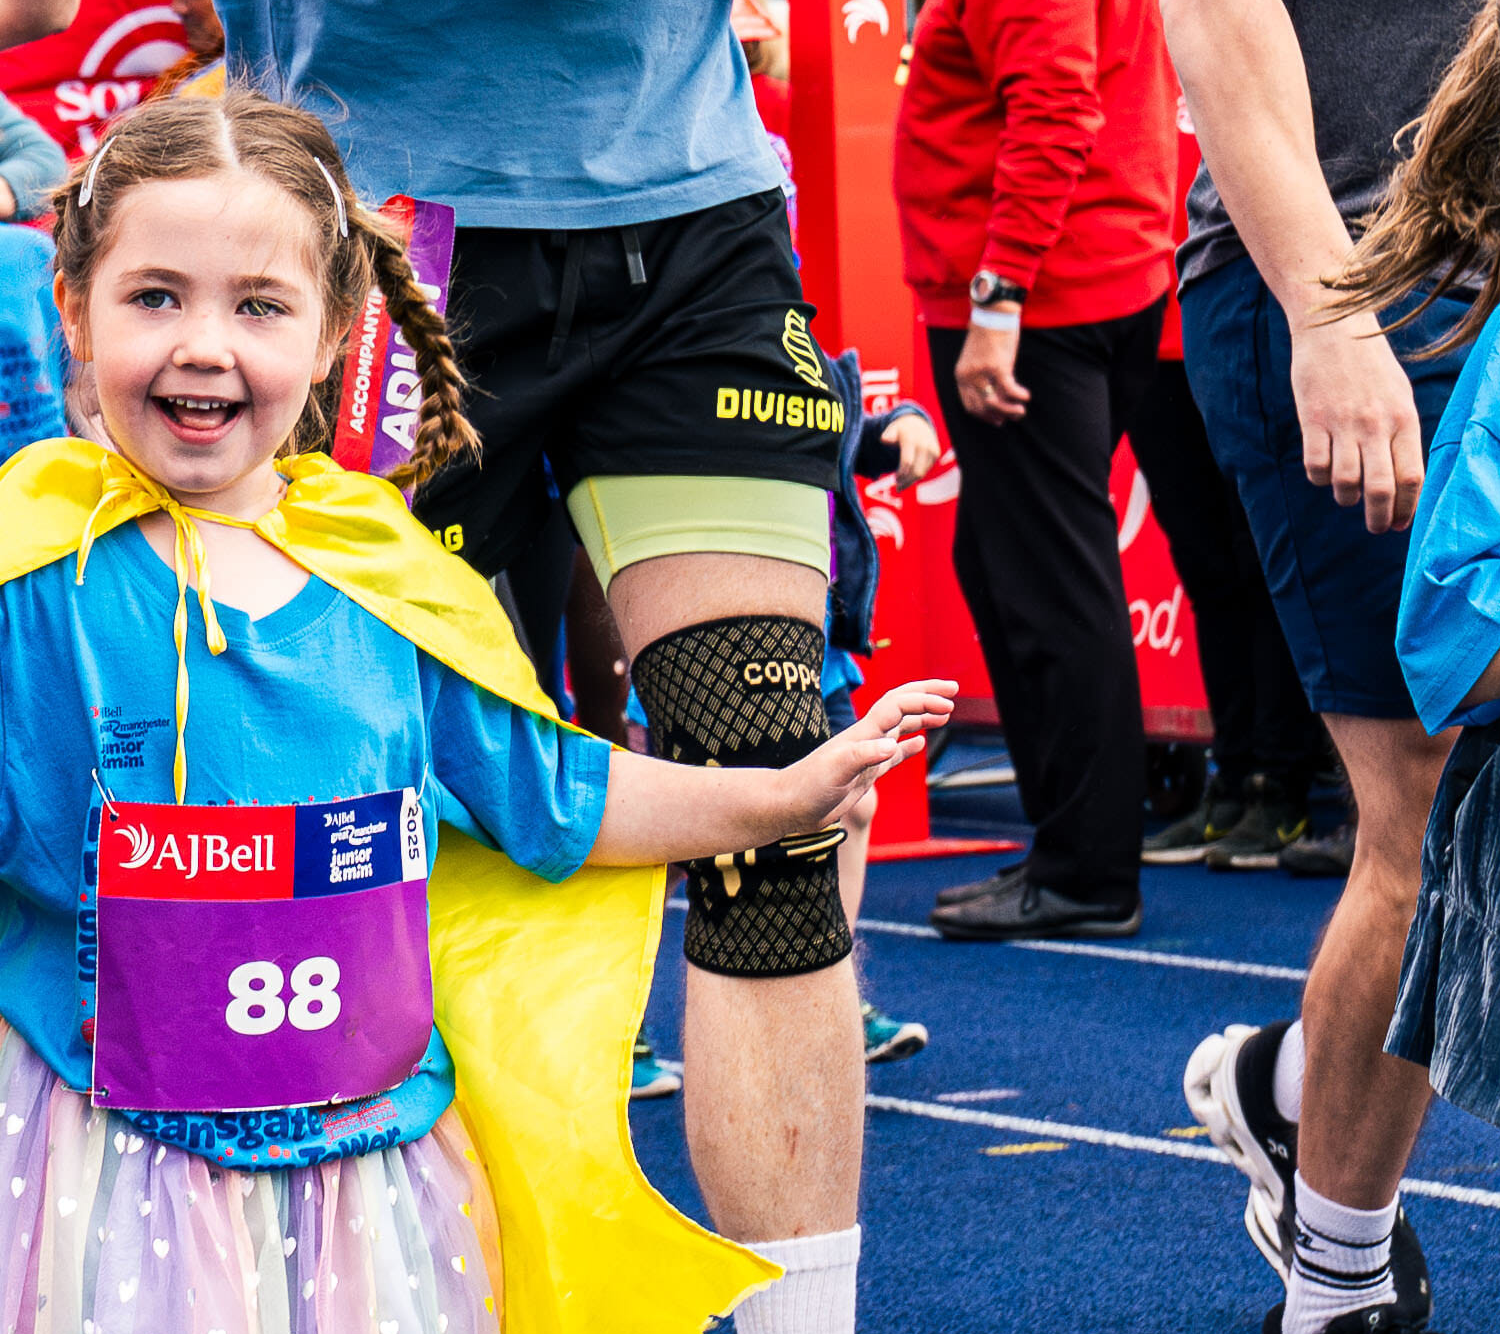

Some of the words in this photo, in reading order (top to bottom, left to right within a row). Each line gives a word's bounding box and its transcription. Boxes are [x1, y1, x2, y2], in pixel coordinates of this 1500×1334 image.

[716, 387, 845, 433] DIVISION
[329, 847, 373, 868] junior
[406, 805, 421, 861] 2025
[224, 956, 341, 1036] 88
